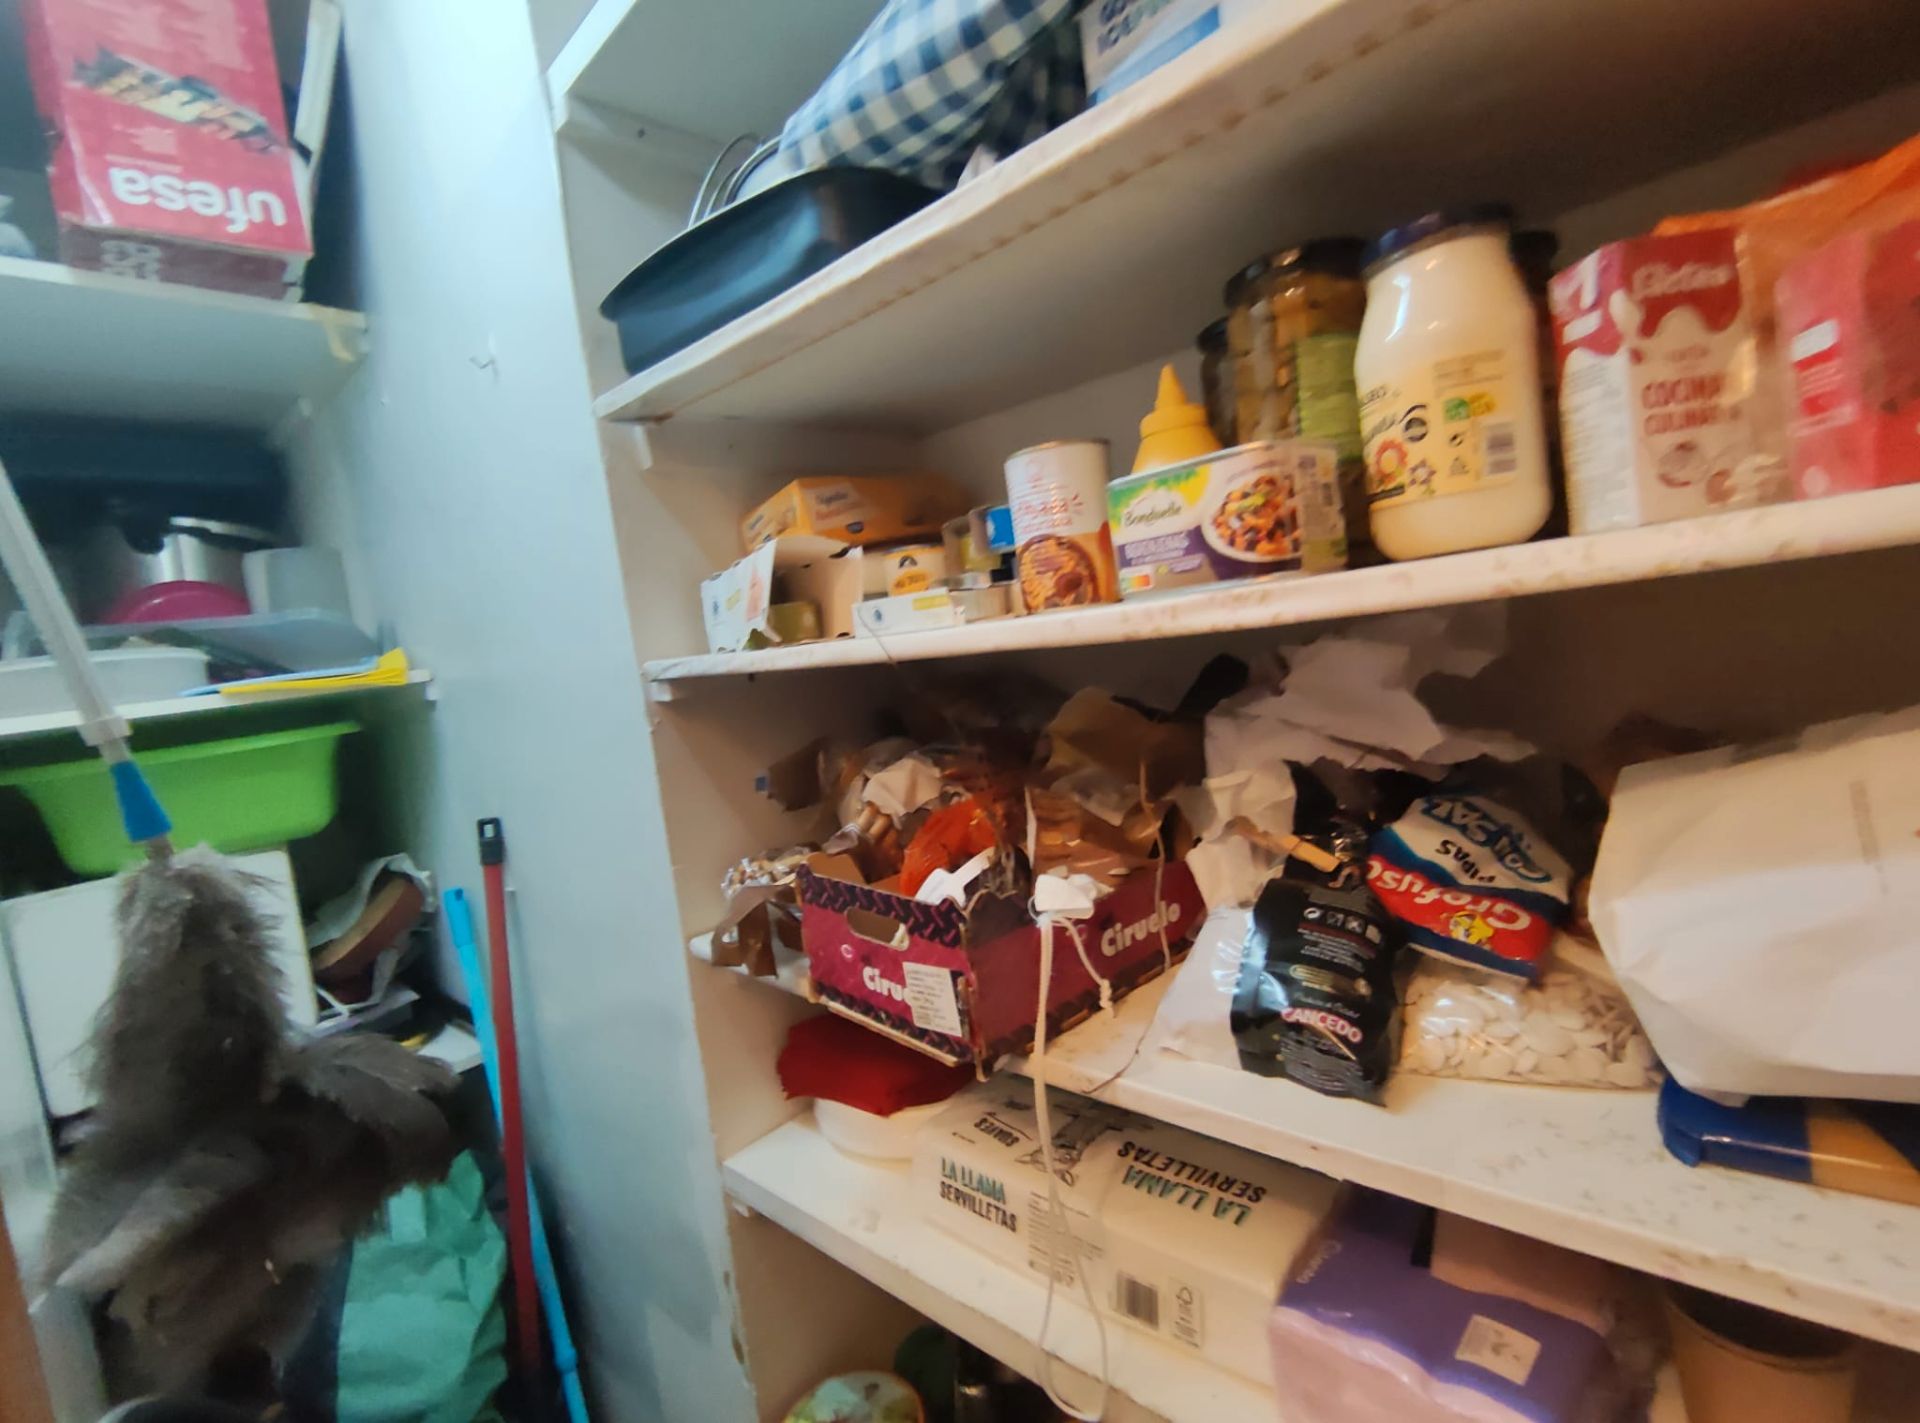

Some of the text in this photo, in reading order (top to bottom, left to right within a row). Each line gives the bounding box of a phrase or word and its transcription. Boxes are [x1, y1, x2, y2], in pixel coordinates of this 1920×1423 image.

[107, 167, 287, 233] ufesa
[1435, 839, 1496, 883] PIPAS
[1101, 900, 1181, 957] Ciruelo
[941, 1157, 1007, 1206] LA LLAMA
[1117, 1140, 1267, 1203] SERVILLETAS
[1121, 1164, 1253, 1226] LA LLAMA
[939, 1180, 1018, 1233] SERVILLETAS
